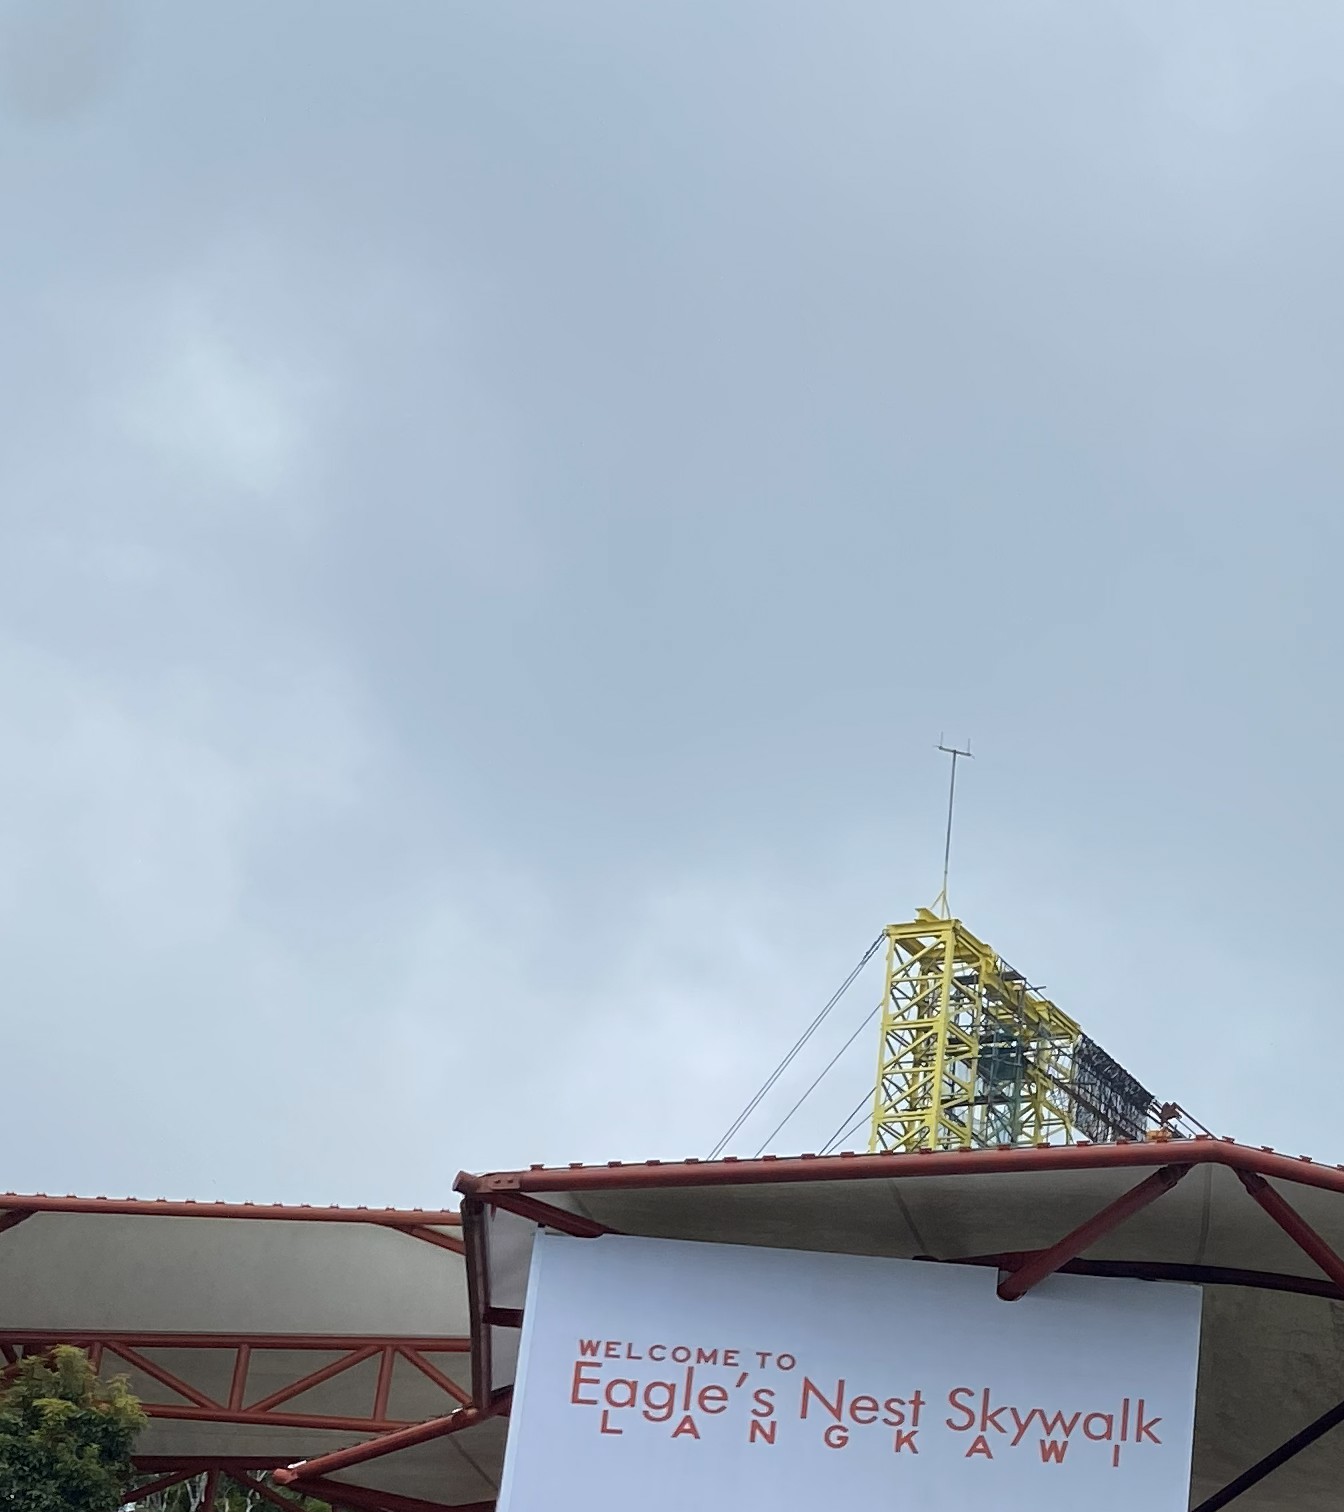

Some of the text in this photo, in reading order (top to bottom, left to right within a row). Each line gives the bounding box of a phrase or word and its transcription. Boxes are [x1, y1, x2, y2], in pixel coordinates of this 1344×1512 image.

[580, 1339, 797, 1371] WELCOME TO
[571, 1361, 1163, 1446] Eagle's Nest Skywalk
